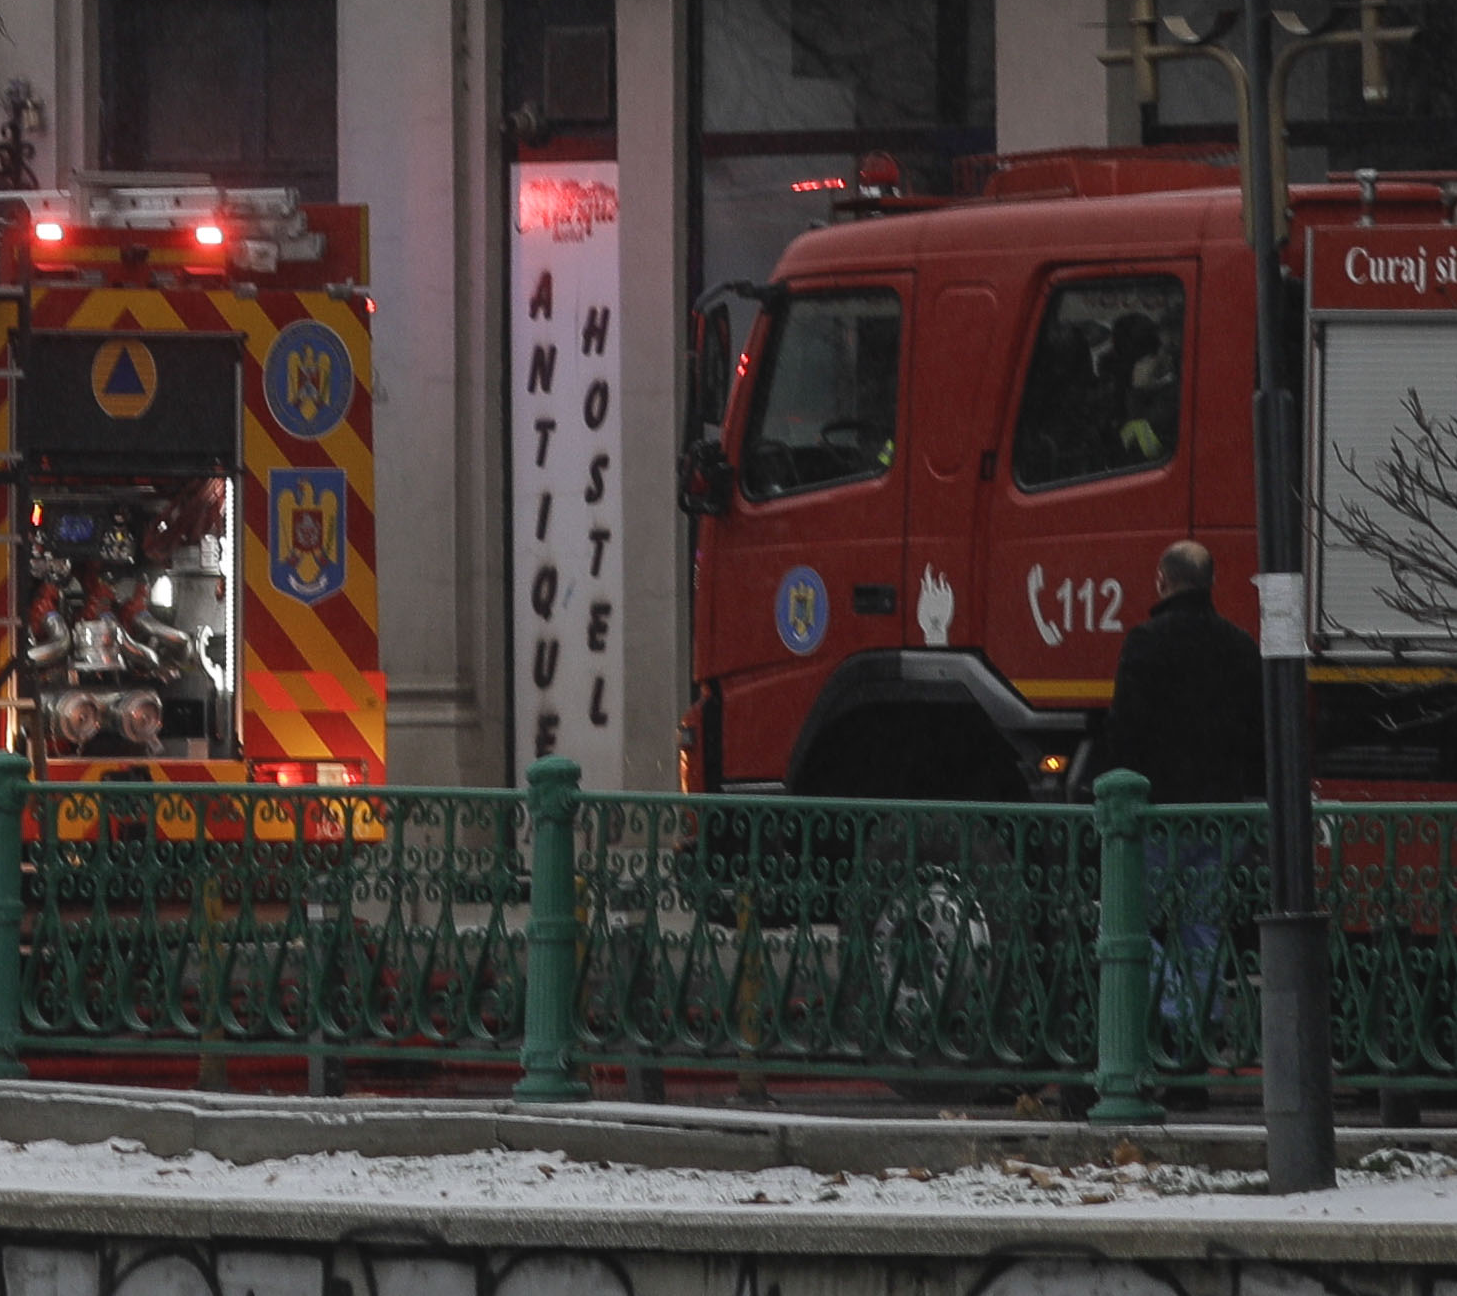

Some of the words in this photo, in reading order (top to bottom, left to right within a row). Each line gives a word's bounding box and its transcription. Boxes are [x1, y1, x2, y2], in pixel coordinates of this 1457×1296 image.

[1344, 246, 1427, 295] Curaj
[1435, 246, 1457, 284] si
[527, 269, 559, 757] ANTIQUE
[582, 306, 611, 727] HOSTEL
[1055, 577, 1124, 633] 112
